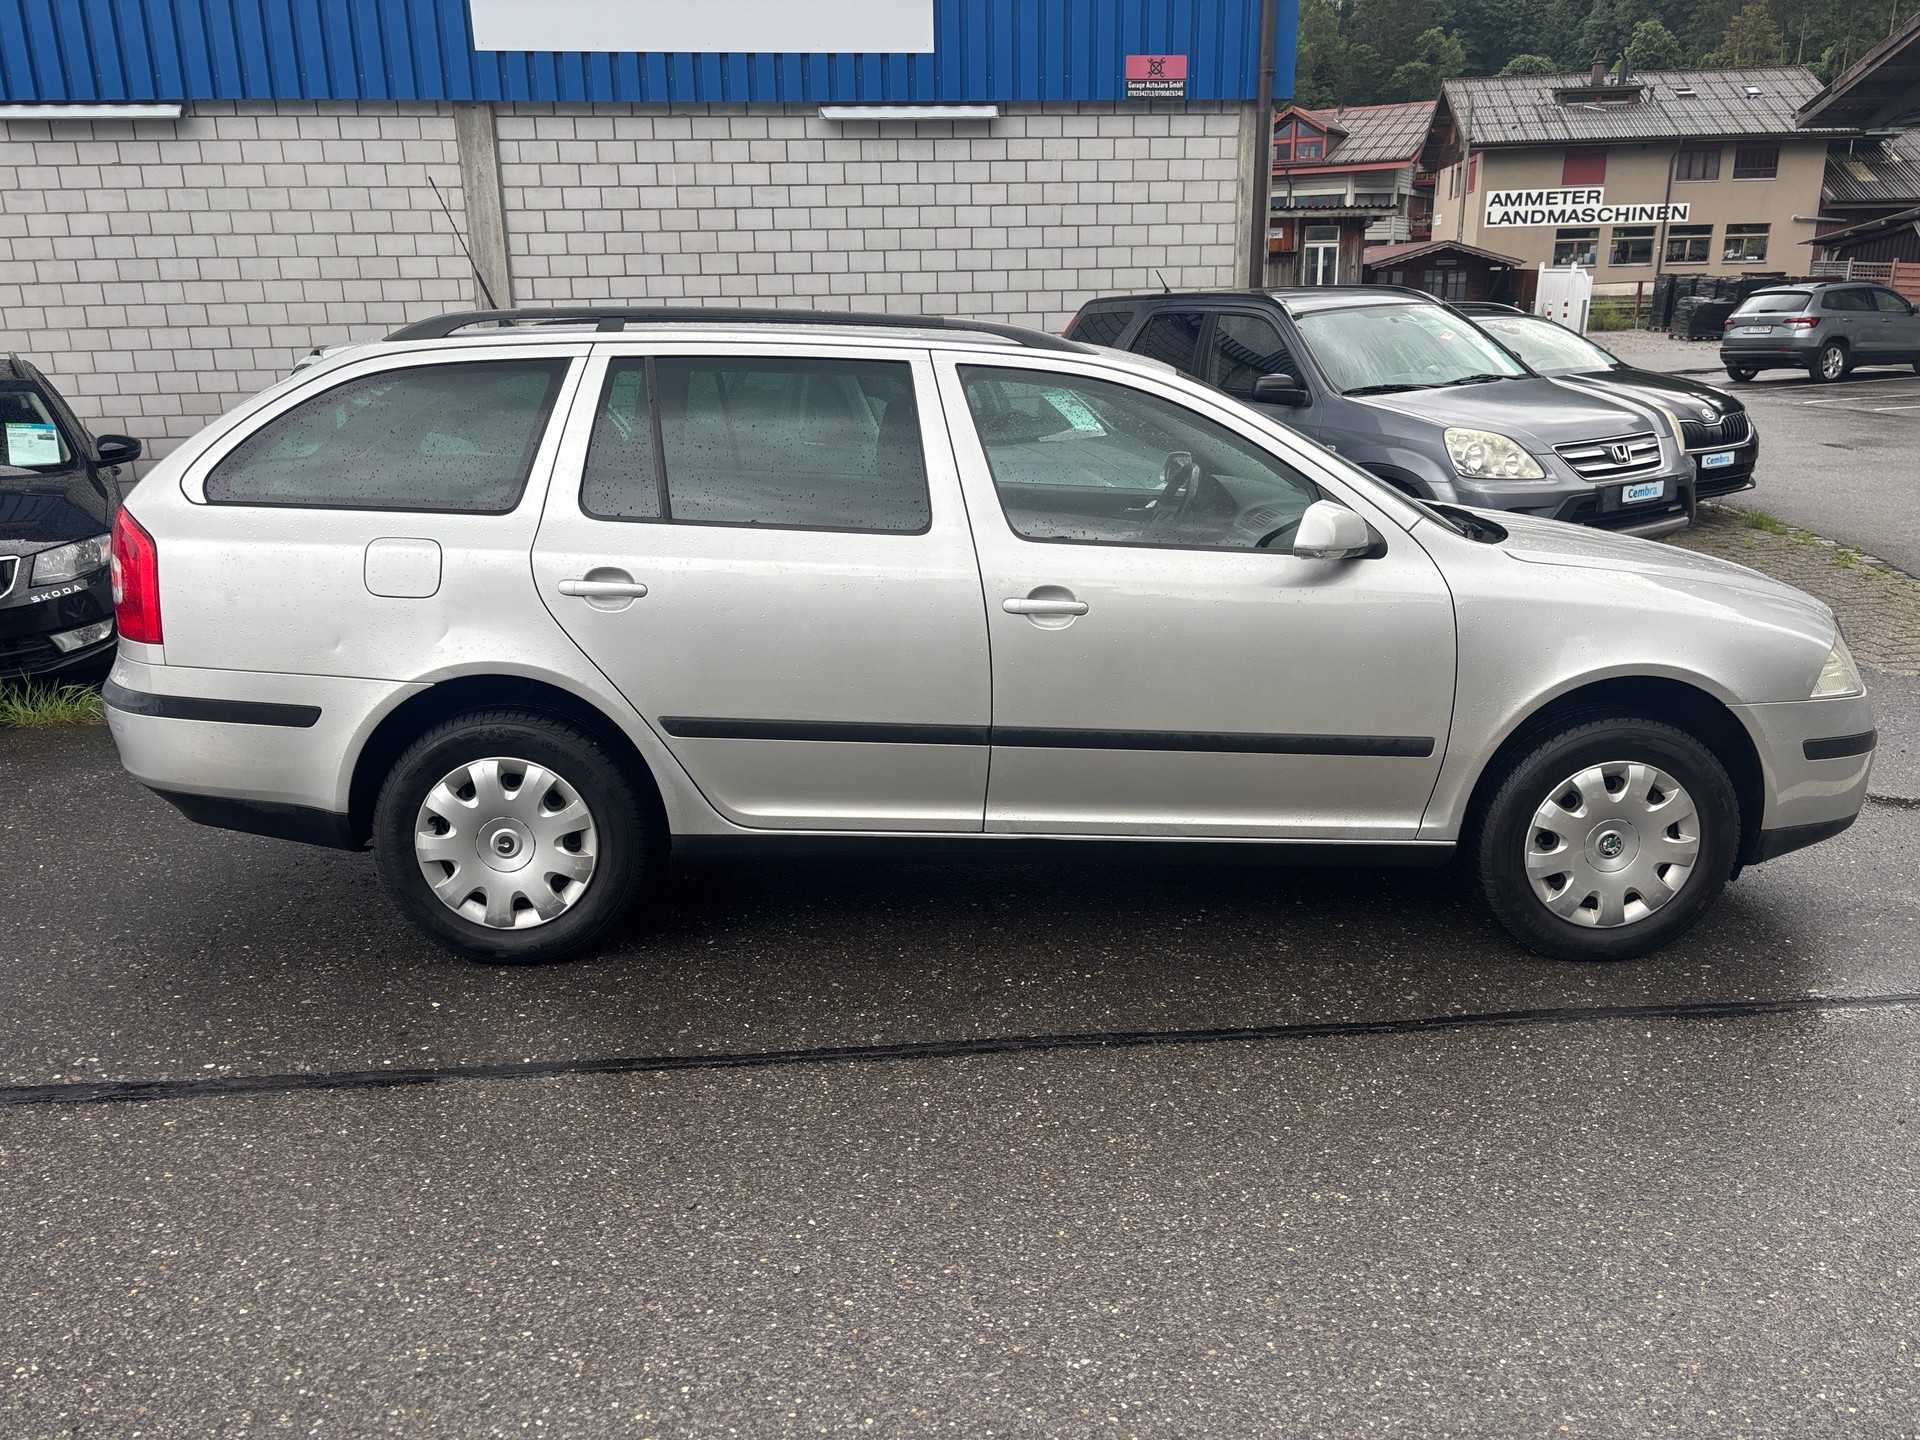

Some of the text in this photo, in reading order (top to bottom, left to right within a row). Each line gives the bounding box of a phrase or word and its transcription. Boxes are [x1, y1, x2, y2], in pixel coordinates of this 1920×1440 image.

[1128, 81, 1145, 89] Garage
[1488, 189, 1602, 208] AMMETER
[1486, 205, 1688, 226] LANDMASCHINEN
[1706, 455, 1730, 465] Cembra
[1628, 485, 1658, 499] Cembra
[31, 585, 82, 603] SKODA
